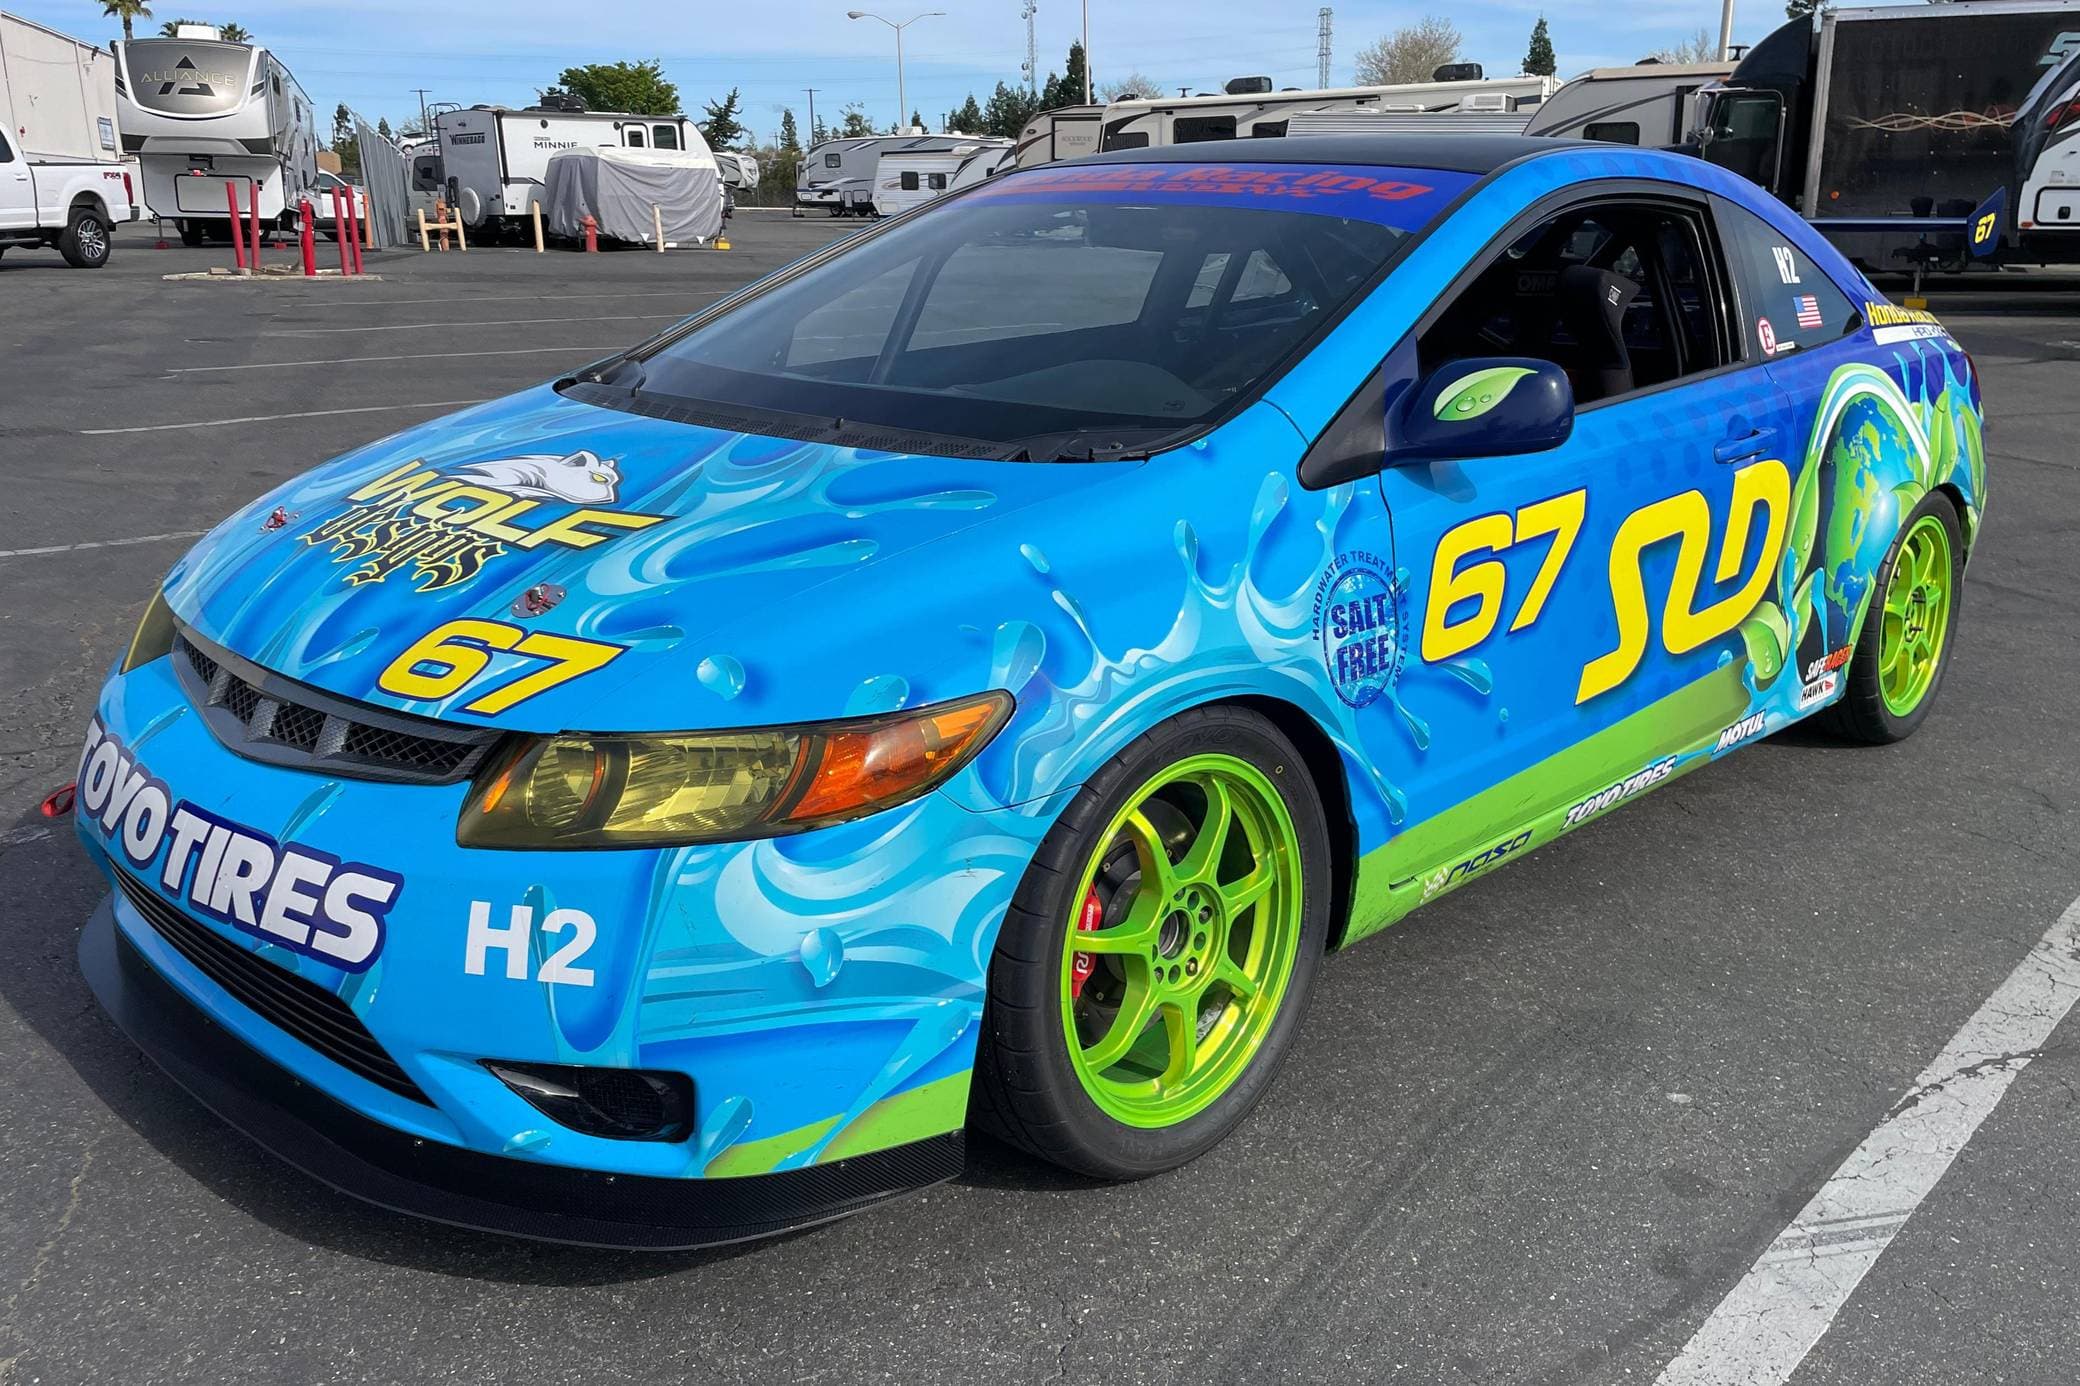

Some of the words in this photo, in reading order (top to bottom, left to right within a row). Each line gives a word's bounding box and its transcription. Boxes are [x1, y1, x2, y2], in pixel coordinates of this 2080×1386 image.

[141, 71, 236, 87] ALLIANCE
[449, 132, 485, 146] WINNEBAGO
[1168, 166, 1434, 201] Racing
[1974, 212, 1996, 244] 67
[1771, 246, 1801, 284] H2
[347, 459, 680, 551] WOLF
[1421, 486, 1588, 664] 67
[1330, 592, 1387, 639] SALT
[375, 617, 632, 719] 67
[1336, 633, 1390, 686] FREE
[1801, 681, 1825, 702] HAWK
[1712, 709, 1766, 755] MOTUL
[1560, 783, 1624, 832] TOYO
[1620, 755, 1678, 801] TIRES
[76, 717, 168, 862] TOYO
[164, 814, 398, 965] TIRES
[465, 900, 598, 987] H2
